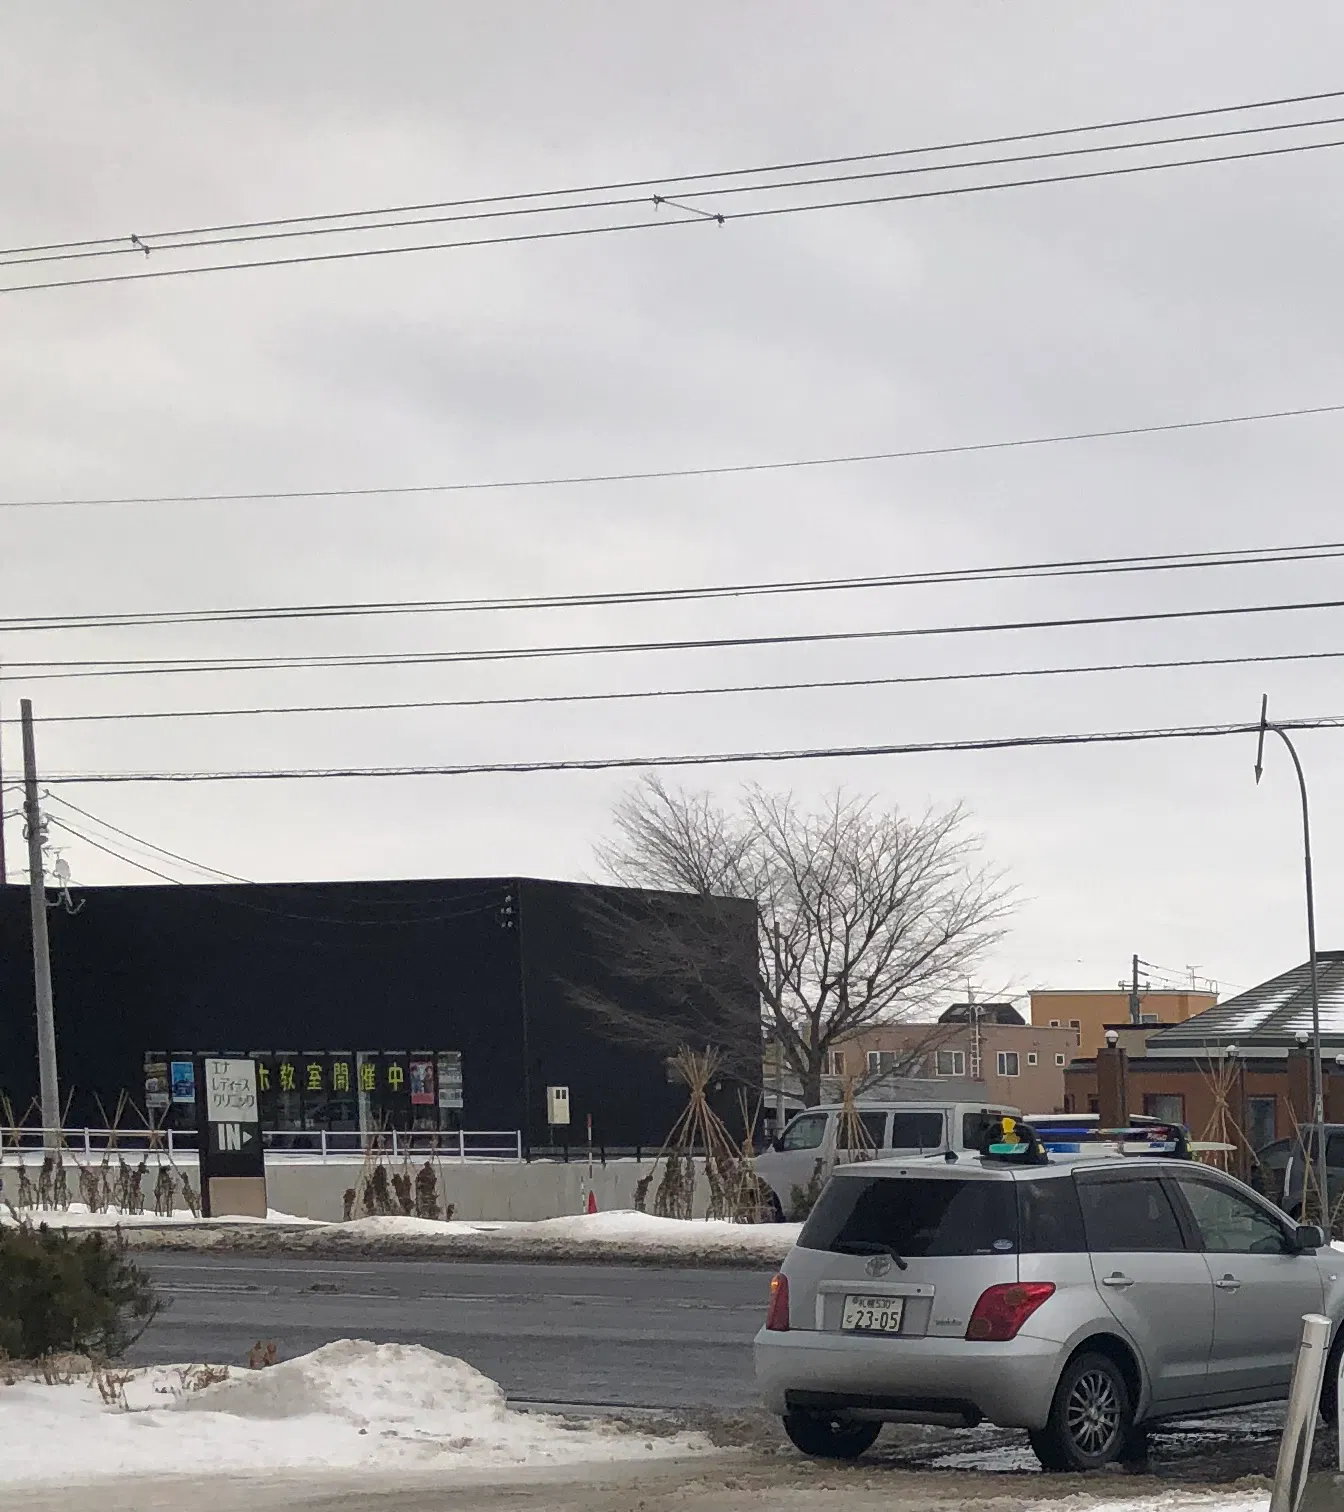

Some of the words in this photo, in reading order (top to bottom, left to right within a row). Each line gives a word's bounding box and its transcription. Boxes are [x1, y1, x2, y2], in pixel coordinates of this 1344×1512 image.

[211, 1061, 231, 1075] エナ
[211, 1077, 251, 1092] レディース
[212, 1094, 256, 1109] クリニック
[218, 1123, 241, 1151] IN
[854, 1309, 900, 1330] 23-05
